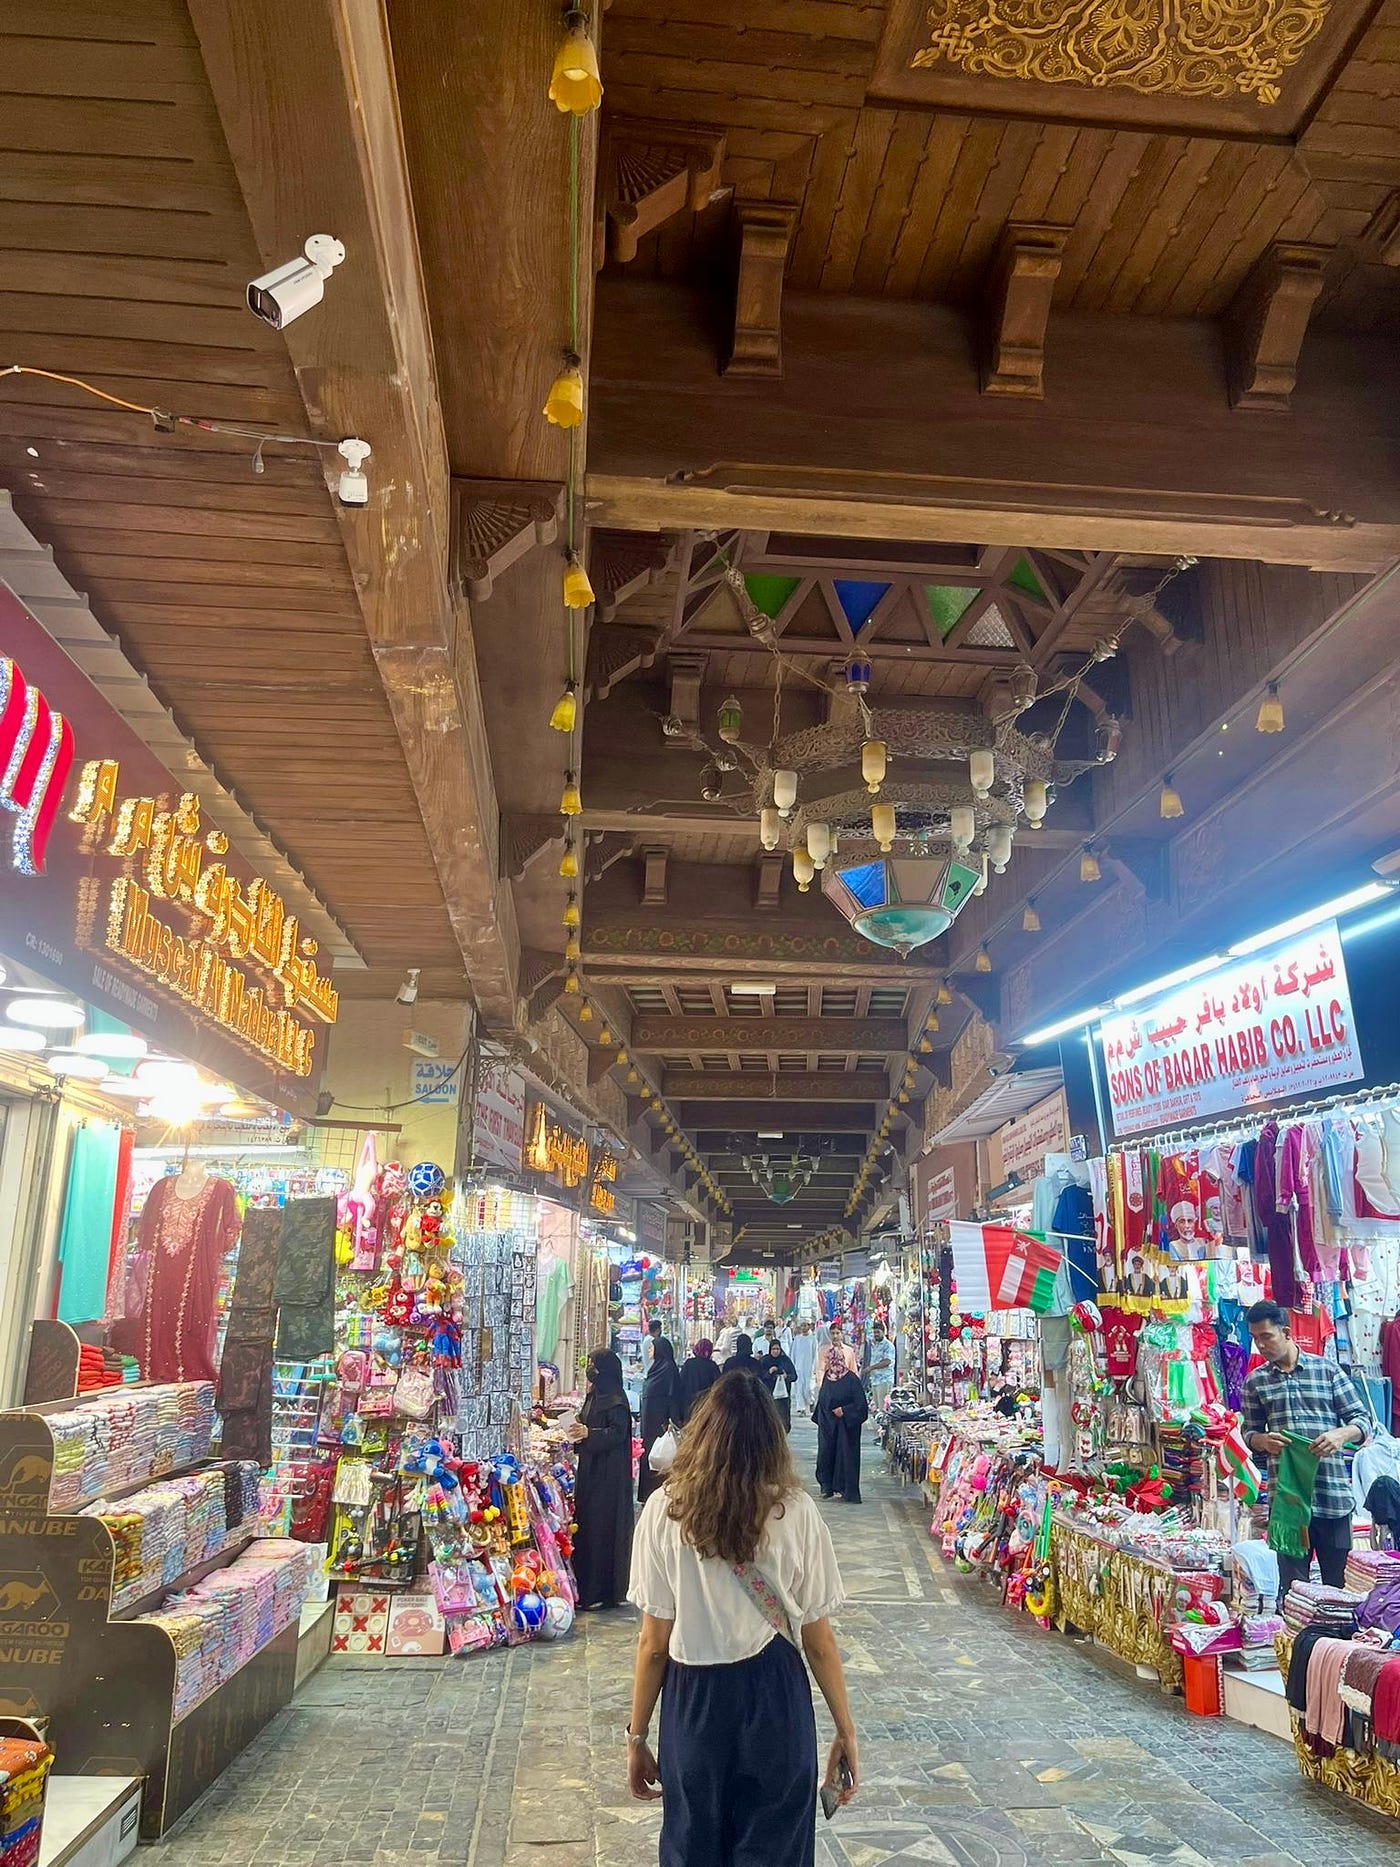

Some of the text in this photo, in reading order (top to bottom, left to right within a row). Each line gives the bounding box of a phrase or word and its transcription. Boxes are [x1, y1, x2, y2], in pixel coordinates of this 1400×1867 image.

[1274, 943, 1336, 997] شركة
[1110, 1065, 1143, 1106] SONS
[1143, 1058, 1161, 1095] OF
[1162, 1043, 1214, 1091] BAQAR
[1215, 1025, 1268, 1075] HABIB
[1270, 1014, 1305, 1058] CO.
[1305, 999, 1345, 1049] LLC
[415, 1063, 456, 1079] حلاقة
[415, 1083, 457, 1095] SALOON
